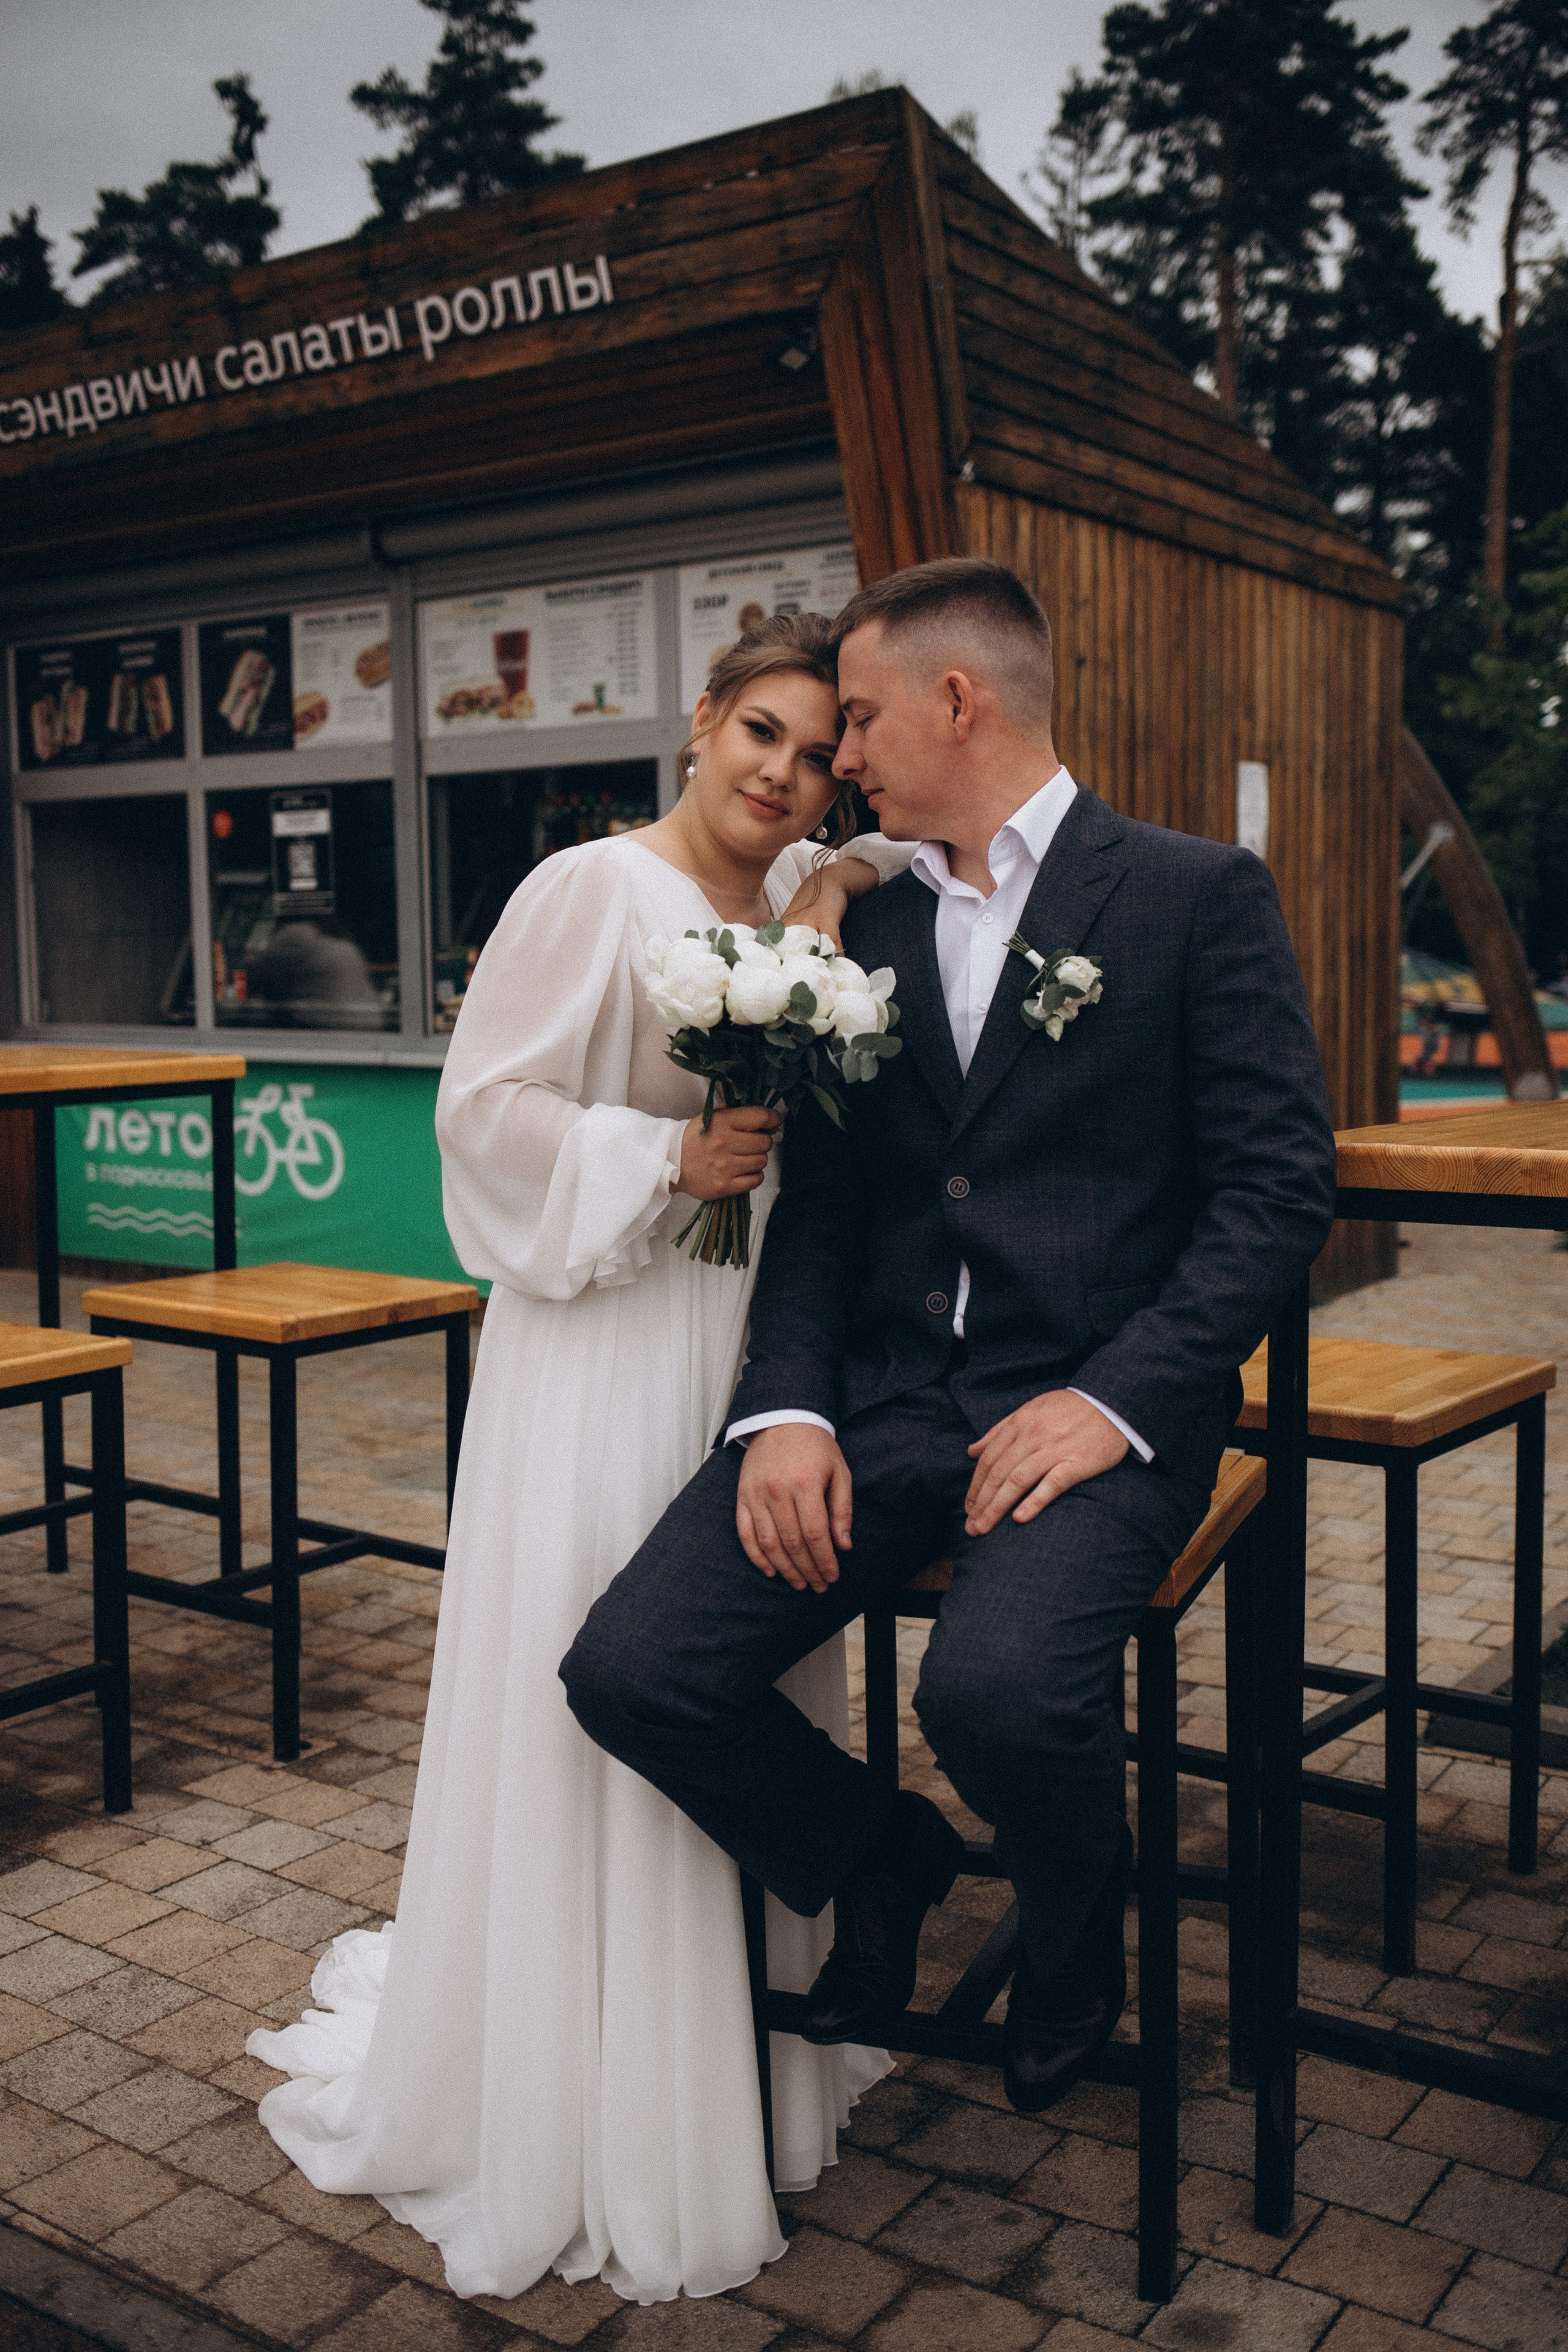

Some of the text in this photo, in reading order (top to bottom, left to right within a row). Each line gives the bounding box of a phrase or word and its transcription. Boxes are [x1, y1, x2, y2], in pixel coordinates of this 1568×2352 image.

[0, 255, 614, 442] сэндвичи салаты роллы
[84, 1107, 214, 1159] лето
